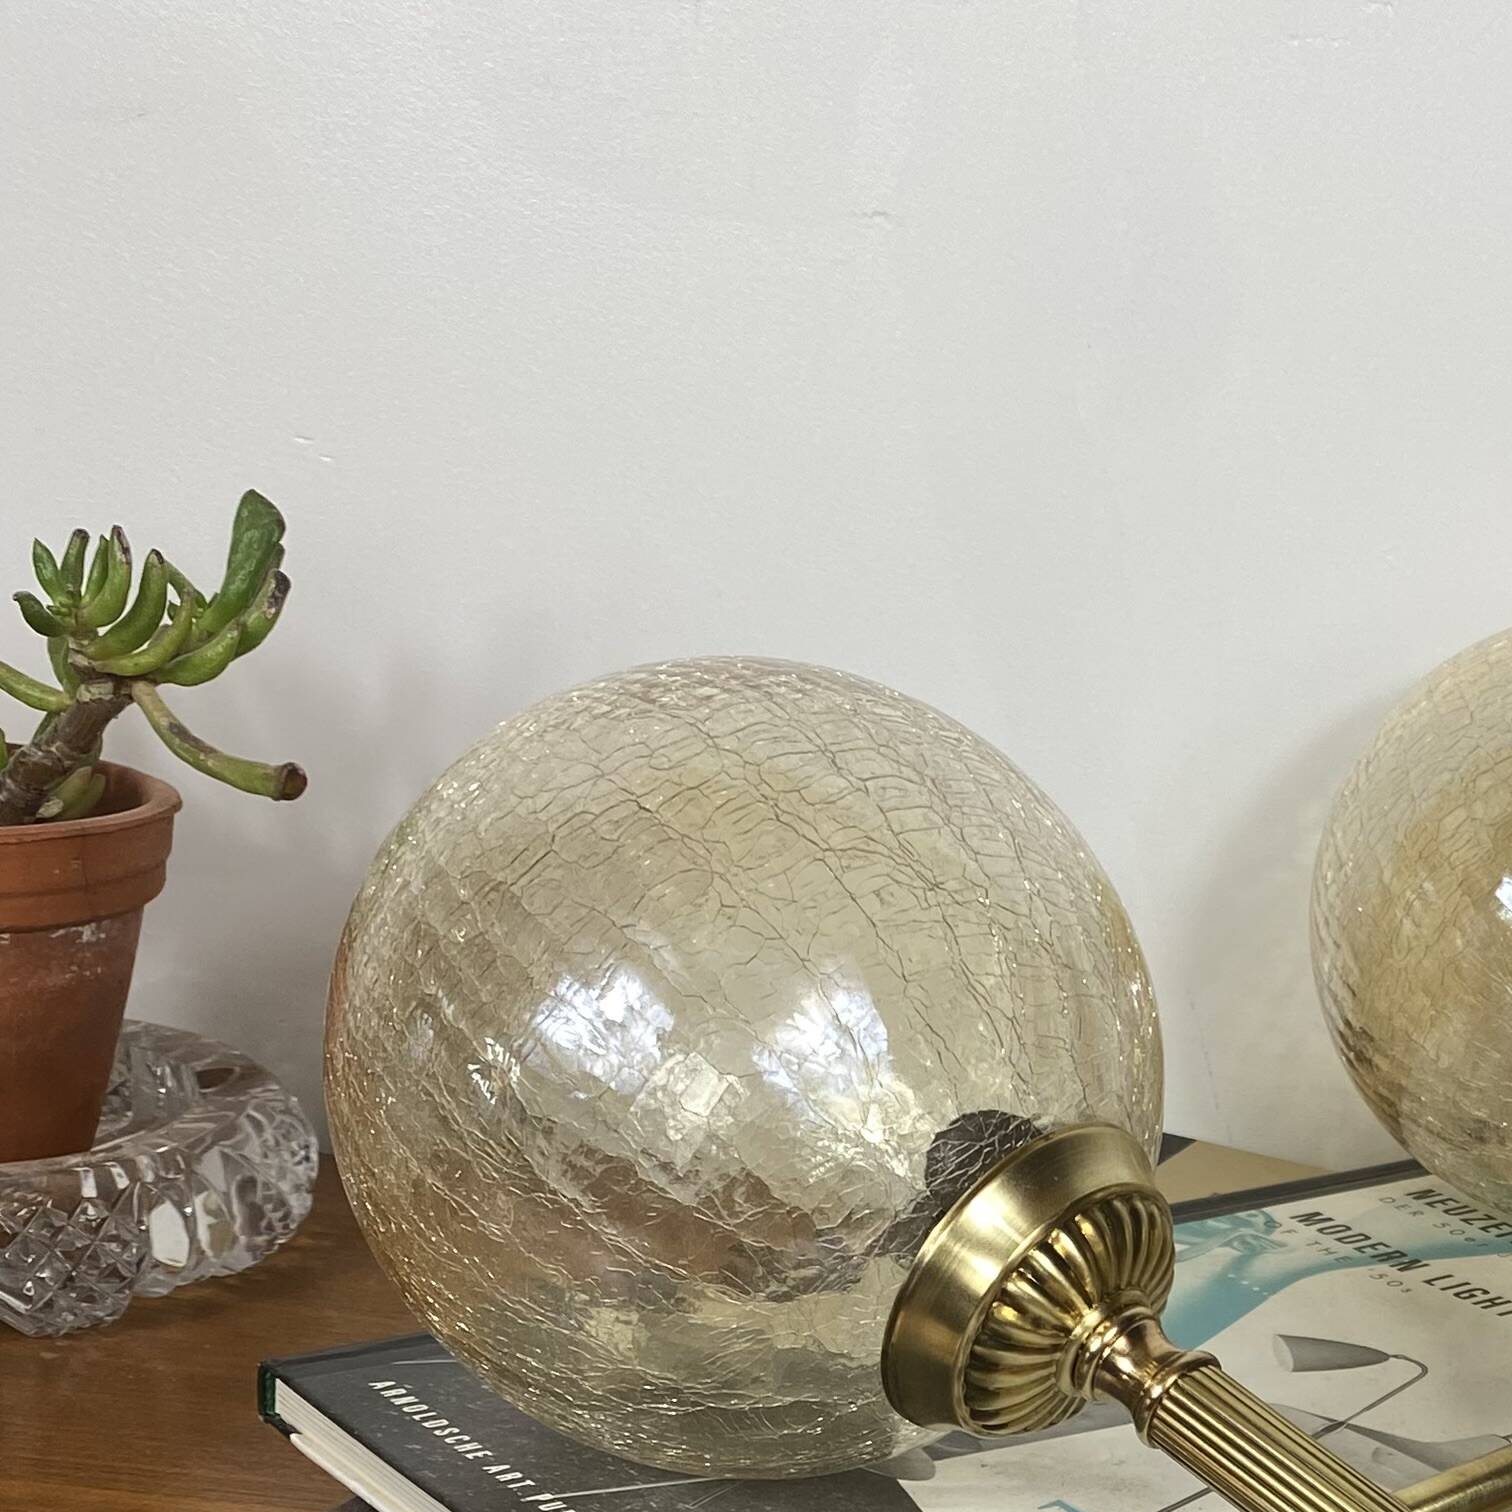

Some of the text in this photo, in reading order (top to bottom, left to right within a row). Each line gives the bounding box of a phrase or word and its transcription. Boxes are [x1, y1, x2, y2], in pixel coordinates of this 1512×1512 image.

[1288, 1211, 1431, 1273] MODERN
[1377, 1196, 1425, 1217] DER
[1431, 1222, 1489, 1248] 50er
[1305, 1240, 1353, 1264] THE
[367, 1380, 494, 1460] ARNOLDSCHE
[481, 1463, 537, 1489] ART
